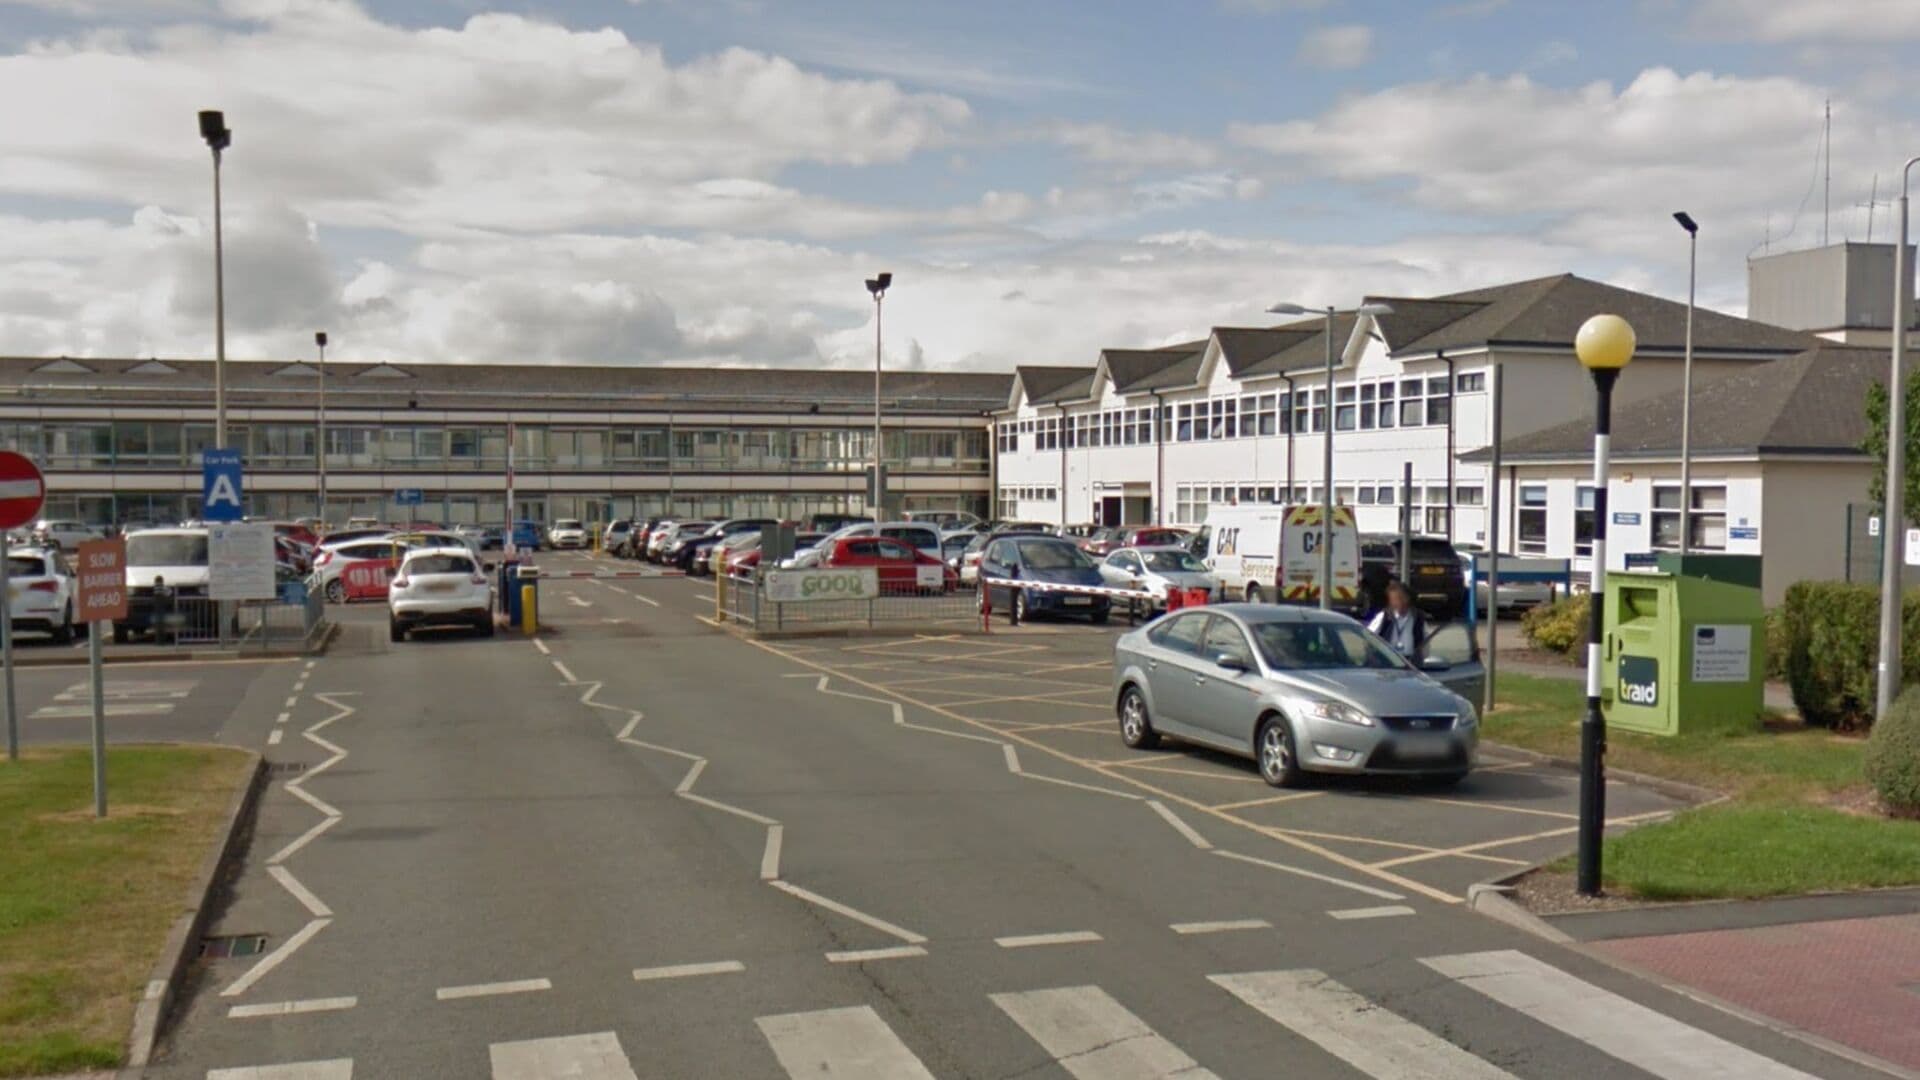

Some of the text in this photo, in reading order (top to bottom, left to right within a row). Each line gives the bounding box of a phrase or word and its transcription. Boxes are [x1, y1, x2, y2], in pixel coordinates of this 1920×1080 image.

[206, 474, 240, 506] A
[1217, 527, 1240, 555] CAT
[90, 552, 116, 568] SLOW
[1240, 559, 1274, 578] Service
[84, 573, 121, 588] BARRIER
[87, 591, 120, 608] AHEAD
